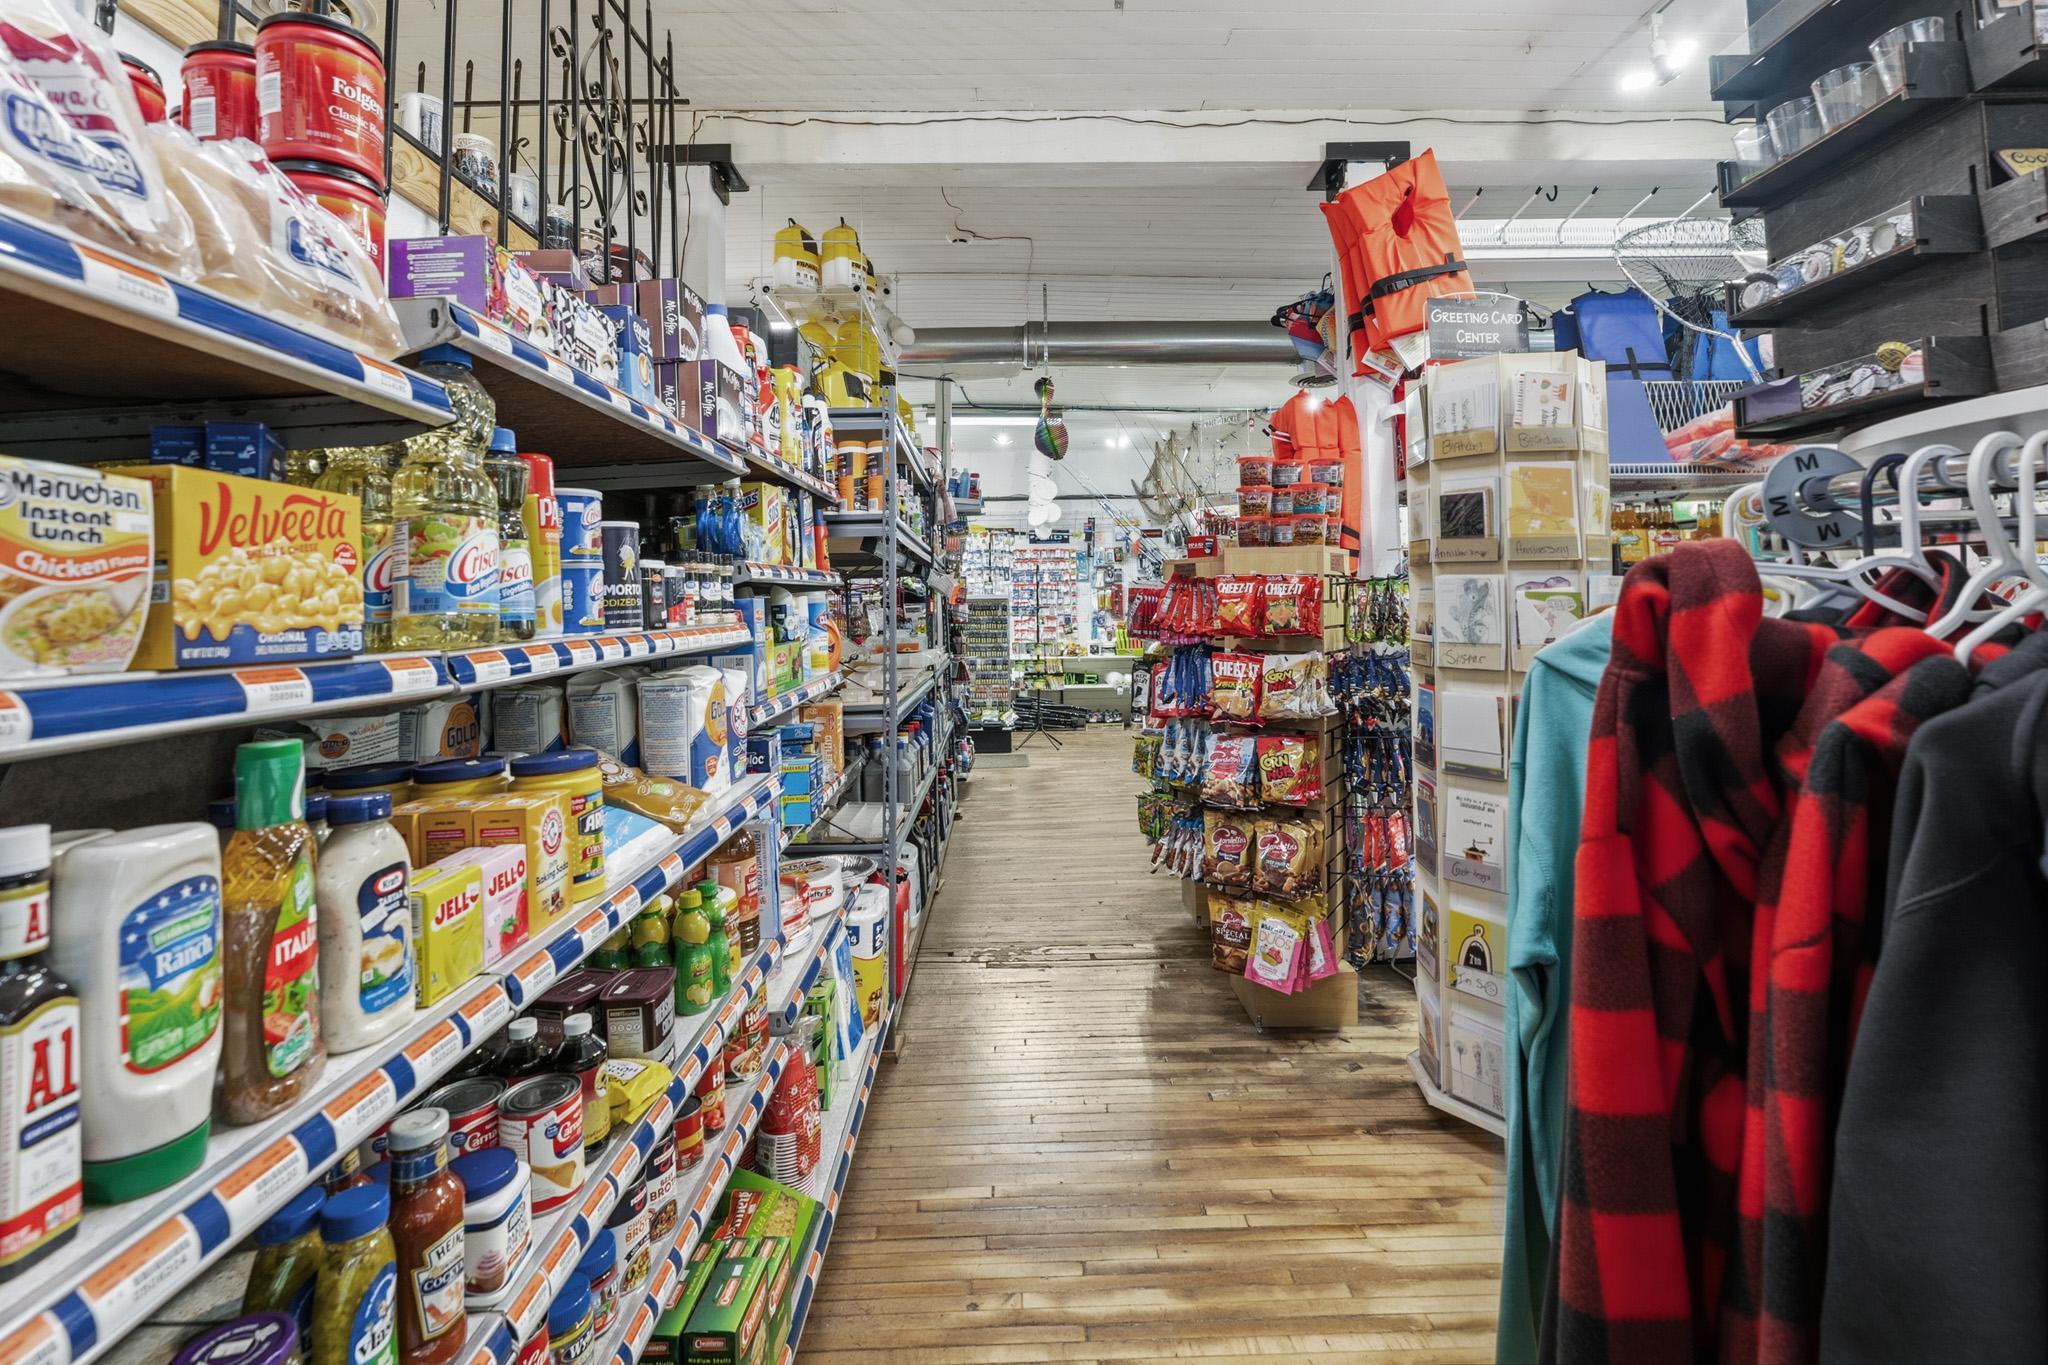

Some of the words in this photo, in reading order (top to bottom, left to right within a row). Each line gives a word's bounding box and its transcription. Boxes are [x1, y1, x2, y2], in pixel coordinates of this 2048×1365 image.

[328, 105, 369, 129] Classic
[1431, 308, 1489, 324] GREETING
[1491, 310, 1523, 325] CARD
[1456, 329, 1501, 344] CENTER
[1794, 453, 1820, 473] M
[12, 470, 140, 510] Maruchan
[21, 500, 113, 526] Instant
[198, 481, 346, 556] Velveeta
[31, 521, 104, 545] Lunch
[16, 549, 110, 578] Chicken
[603, 583, 642, 596] MORTO
[258, 631, 307, 643] ORIGINAL
[447, 721, 478, 748] GOLD
[1260, 755, 1289, 771] CORN
[488, 859, 525, 897] JELL-O
[536, 871, 555, 887] Baking
[434, 893, 480, 927] JELL-O
[154, 934, 213, 979] Ranch
